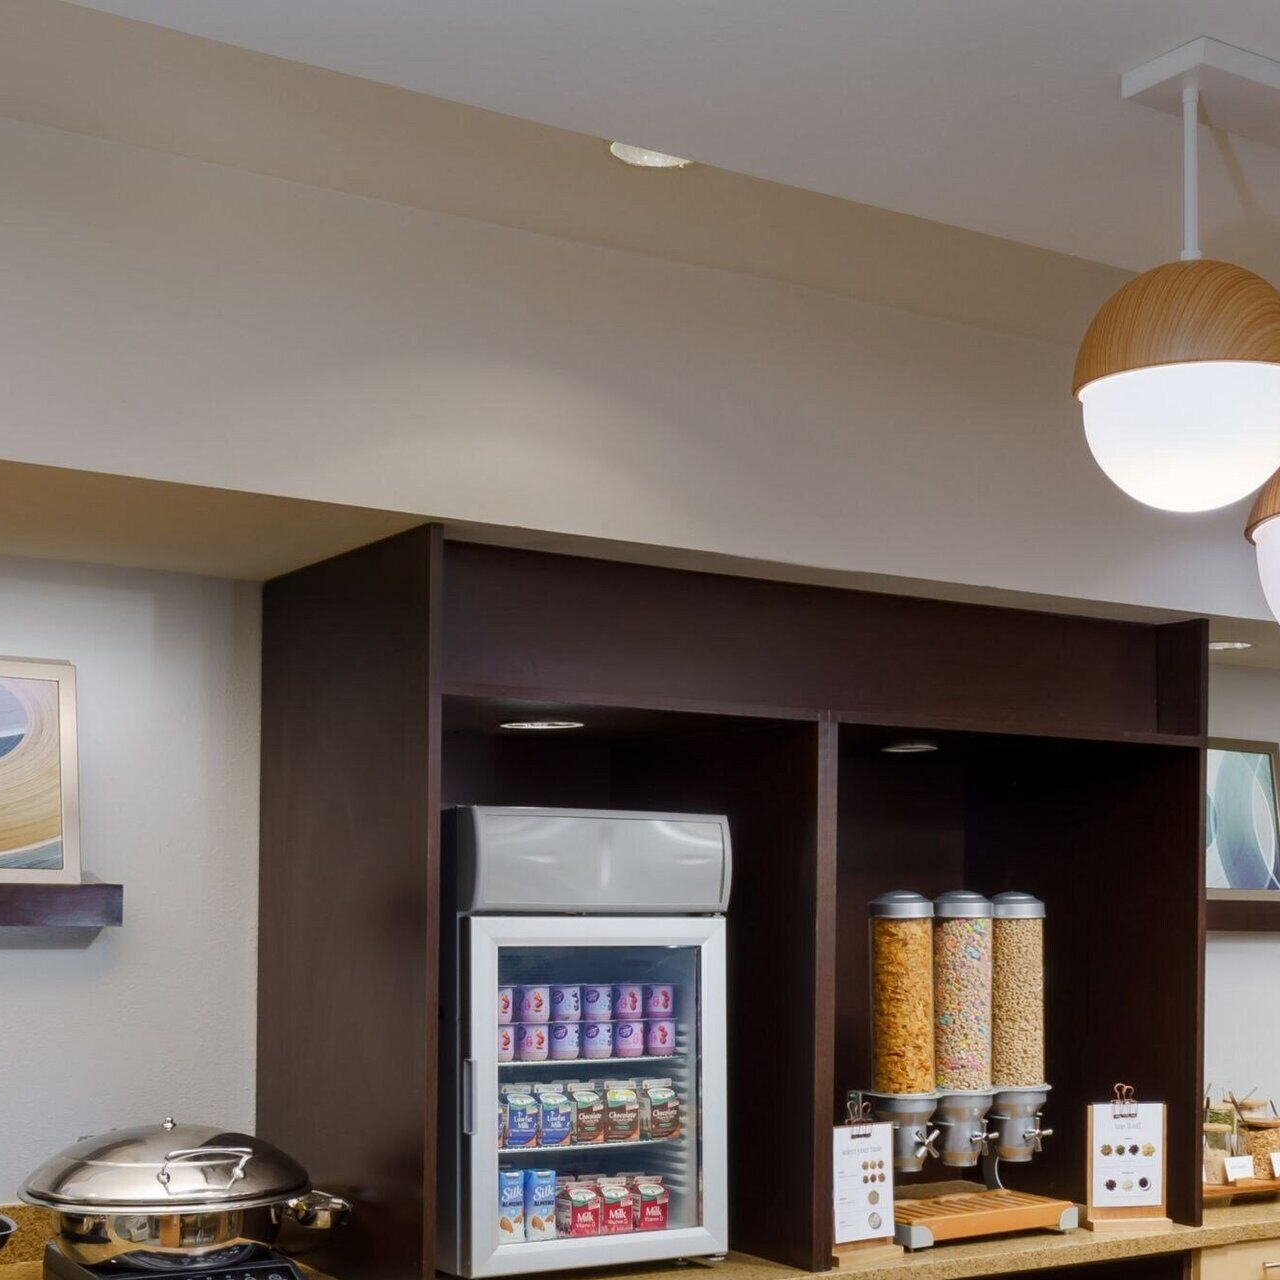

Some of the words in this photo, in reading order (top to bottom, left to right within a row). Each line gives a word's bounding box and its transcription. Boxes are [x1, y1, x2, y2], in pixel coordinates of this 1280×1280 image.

[608, 1111, 637, 1120] Chocolate
[501, 1185, 524, 1202] Silk
[533, 1184, 555, 1201] Silk
[577, 1211, 594, 1223] Milk
[609, 1208, 627, 1220] Milk
[645, 1206, 663, 1217] Milk
